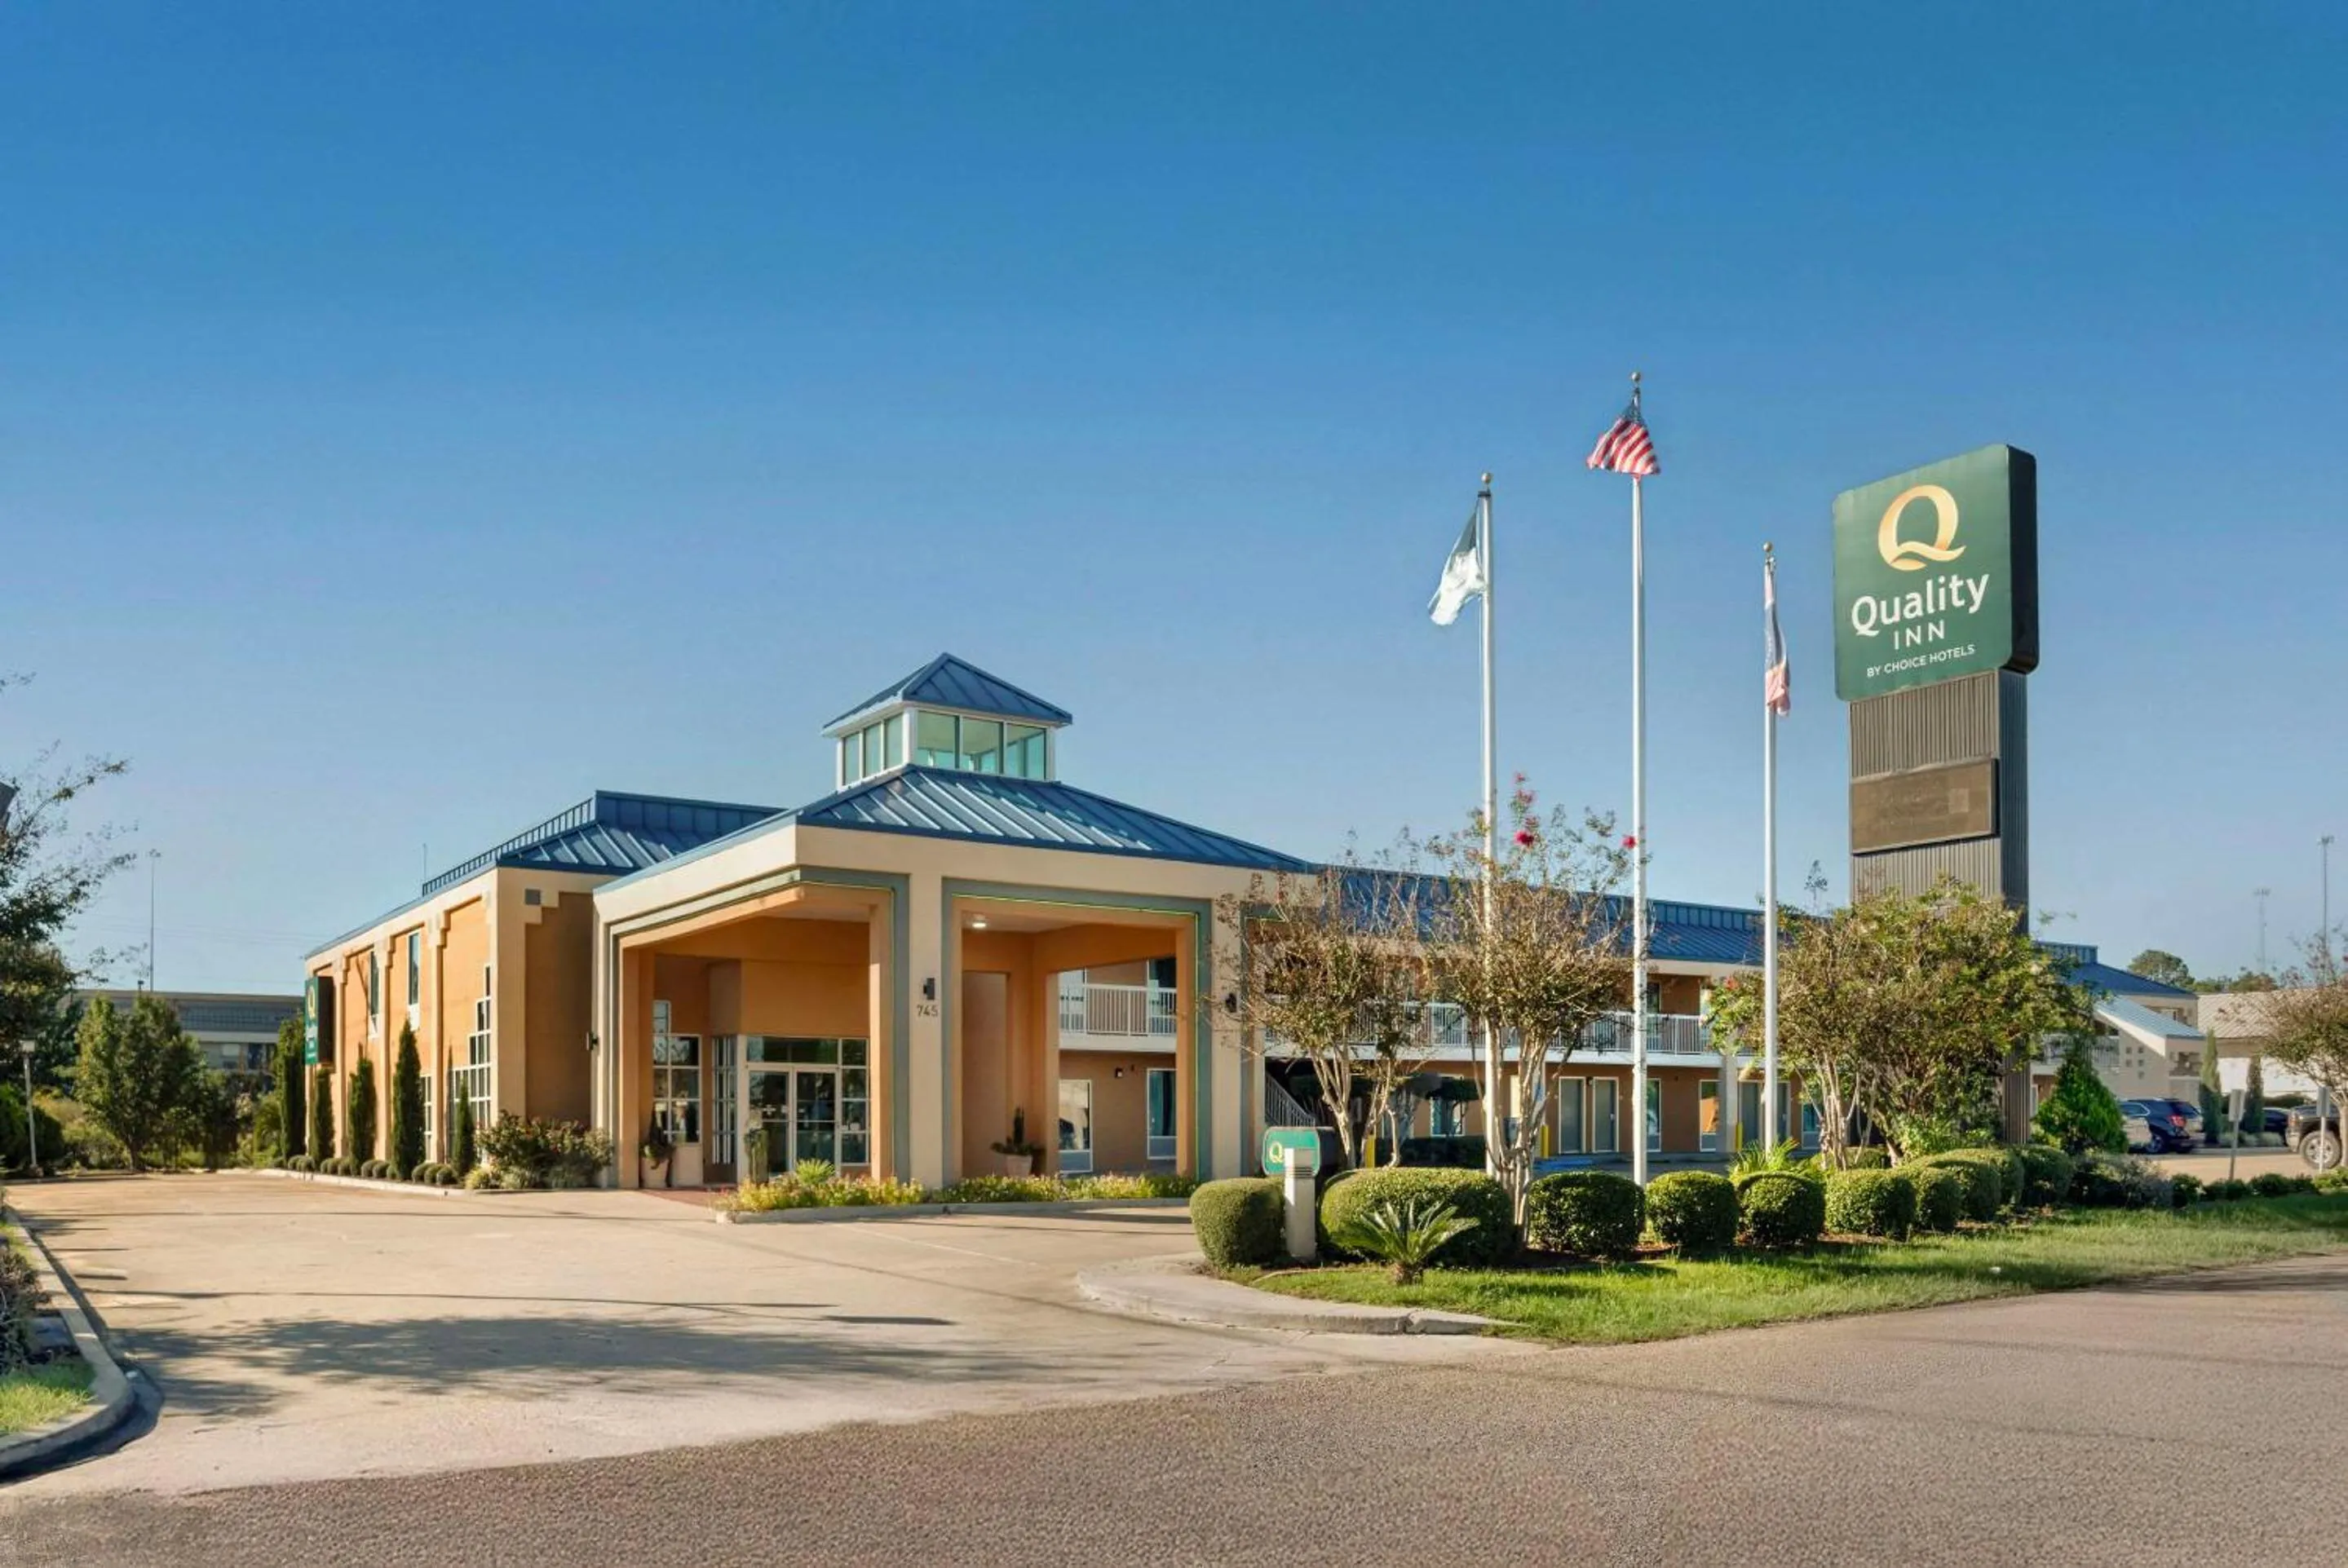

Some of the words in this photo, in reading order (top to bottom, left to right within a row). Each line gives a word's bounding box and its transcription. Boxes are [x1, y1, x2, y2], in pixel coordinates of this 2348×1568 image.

[1877, 484, 1966, 571] Q
[1851, 574, 1990, 637] Quality
[1895, 620, 1945, 650] INN
[1866, 666, 1882, 678] BY
[1884, 655, 1926, 674] CHOICE
[1929, 644, 1975, 664] HOTELS
[917, 1004, 939, 1018] 745
[1269, 1142, 1285, 1164] Q
